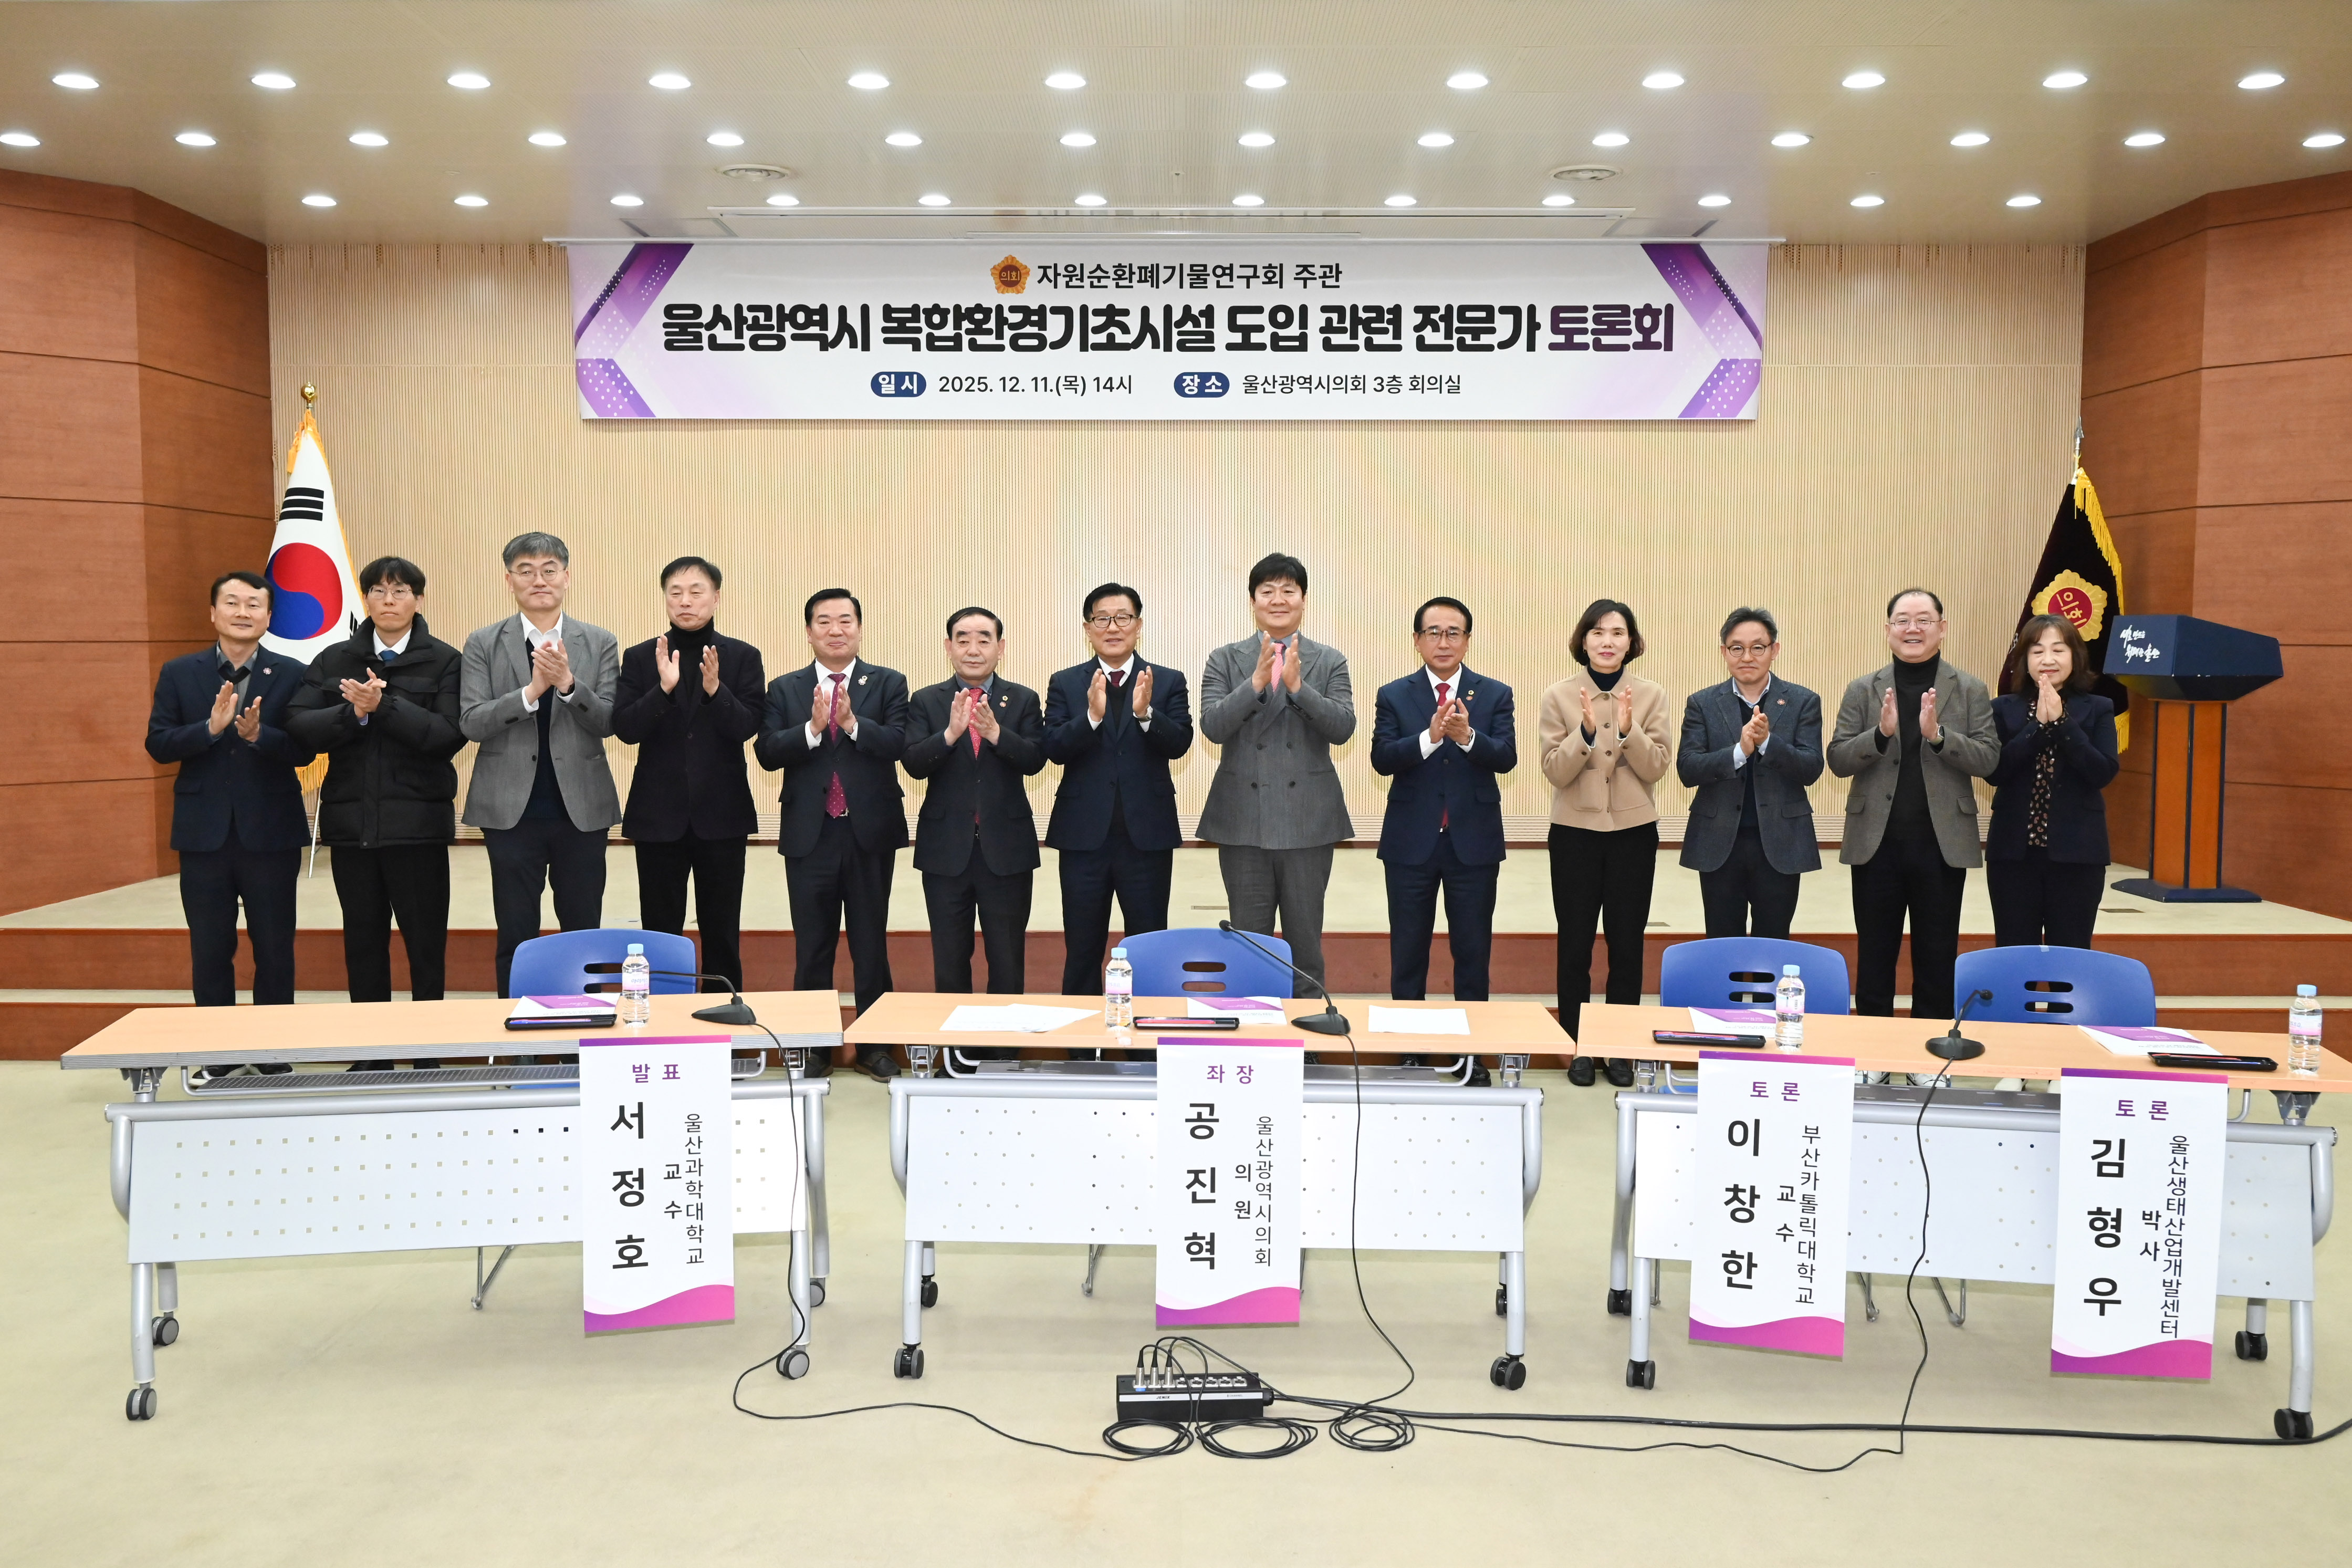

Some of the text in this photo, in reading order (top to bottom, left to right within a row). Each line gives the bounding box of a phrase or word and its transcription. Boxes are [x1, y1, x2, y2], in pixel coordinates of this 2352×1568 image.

[1000, 270, 1020, 281] 의회
[1038, 263, 1342, 289] 자원순환폐기물연구회 주관
[663, 304, 1674, 352] 울산광역시 복합환경기초시설 도입 관련 전문가 토론회
[939, 377, 992, 392] 2025.
[999, 377, 1025, 392] 12.
[1031, 376, 1085, 396] 11.(목)
[1093, 375, 1131, 394] 14시
[1243, 375, 1365, 394] 울산광역시의회
[1374, 375, 1403, 394] 3층
[1409, 375, 1460, 394] 회의실
[2056, 592, 2087, 625] 의회
[611, 1102, 648, 1269] 서정호
[663, 1164, 682, 1219] 교수
[685, 1114, 704, 1263] 울산과학대학교
[1185, 1103, 1219, 1269] 공진혁
[1234, 1163, 1251, 1219] 의원
[1255, 1116, 1273, 1266] 울산광역시의회
[1722, 1119, 1760, 1289] 이창한
[1775, 1185, 1796, 1242] 교수
[1795, 1125, 1821, 1304] 부산카톨릭대학교
[2084, 1139, 2125, 1316] 김형우
[2139, 1210, 2162, 1262] 박사
[2160, 1135, 2190, 1339] 울산생태산업개발센터
